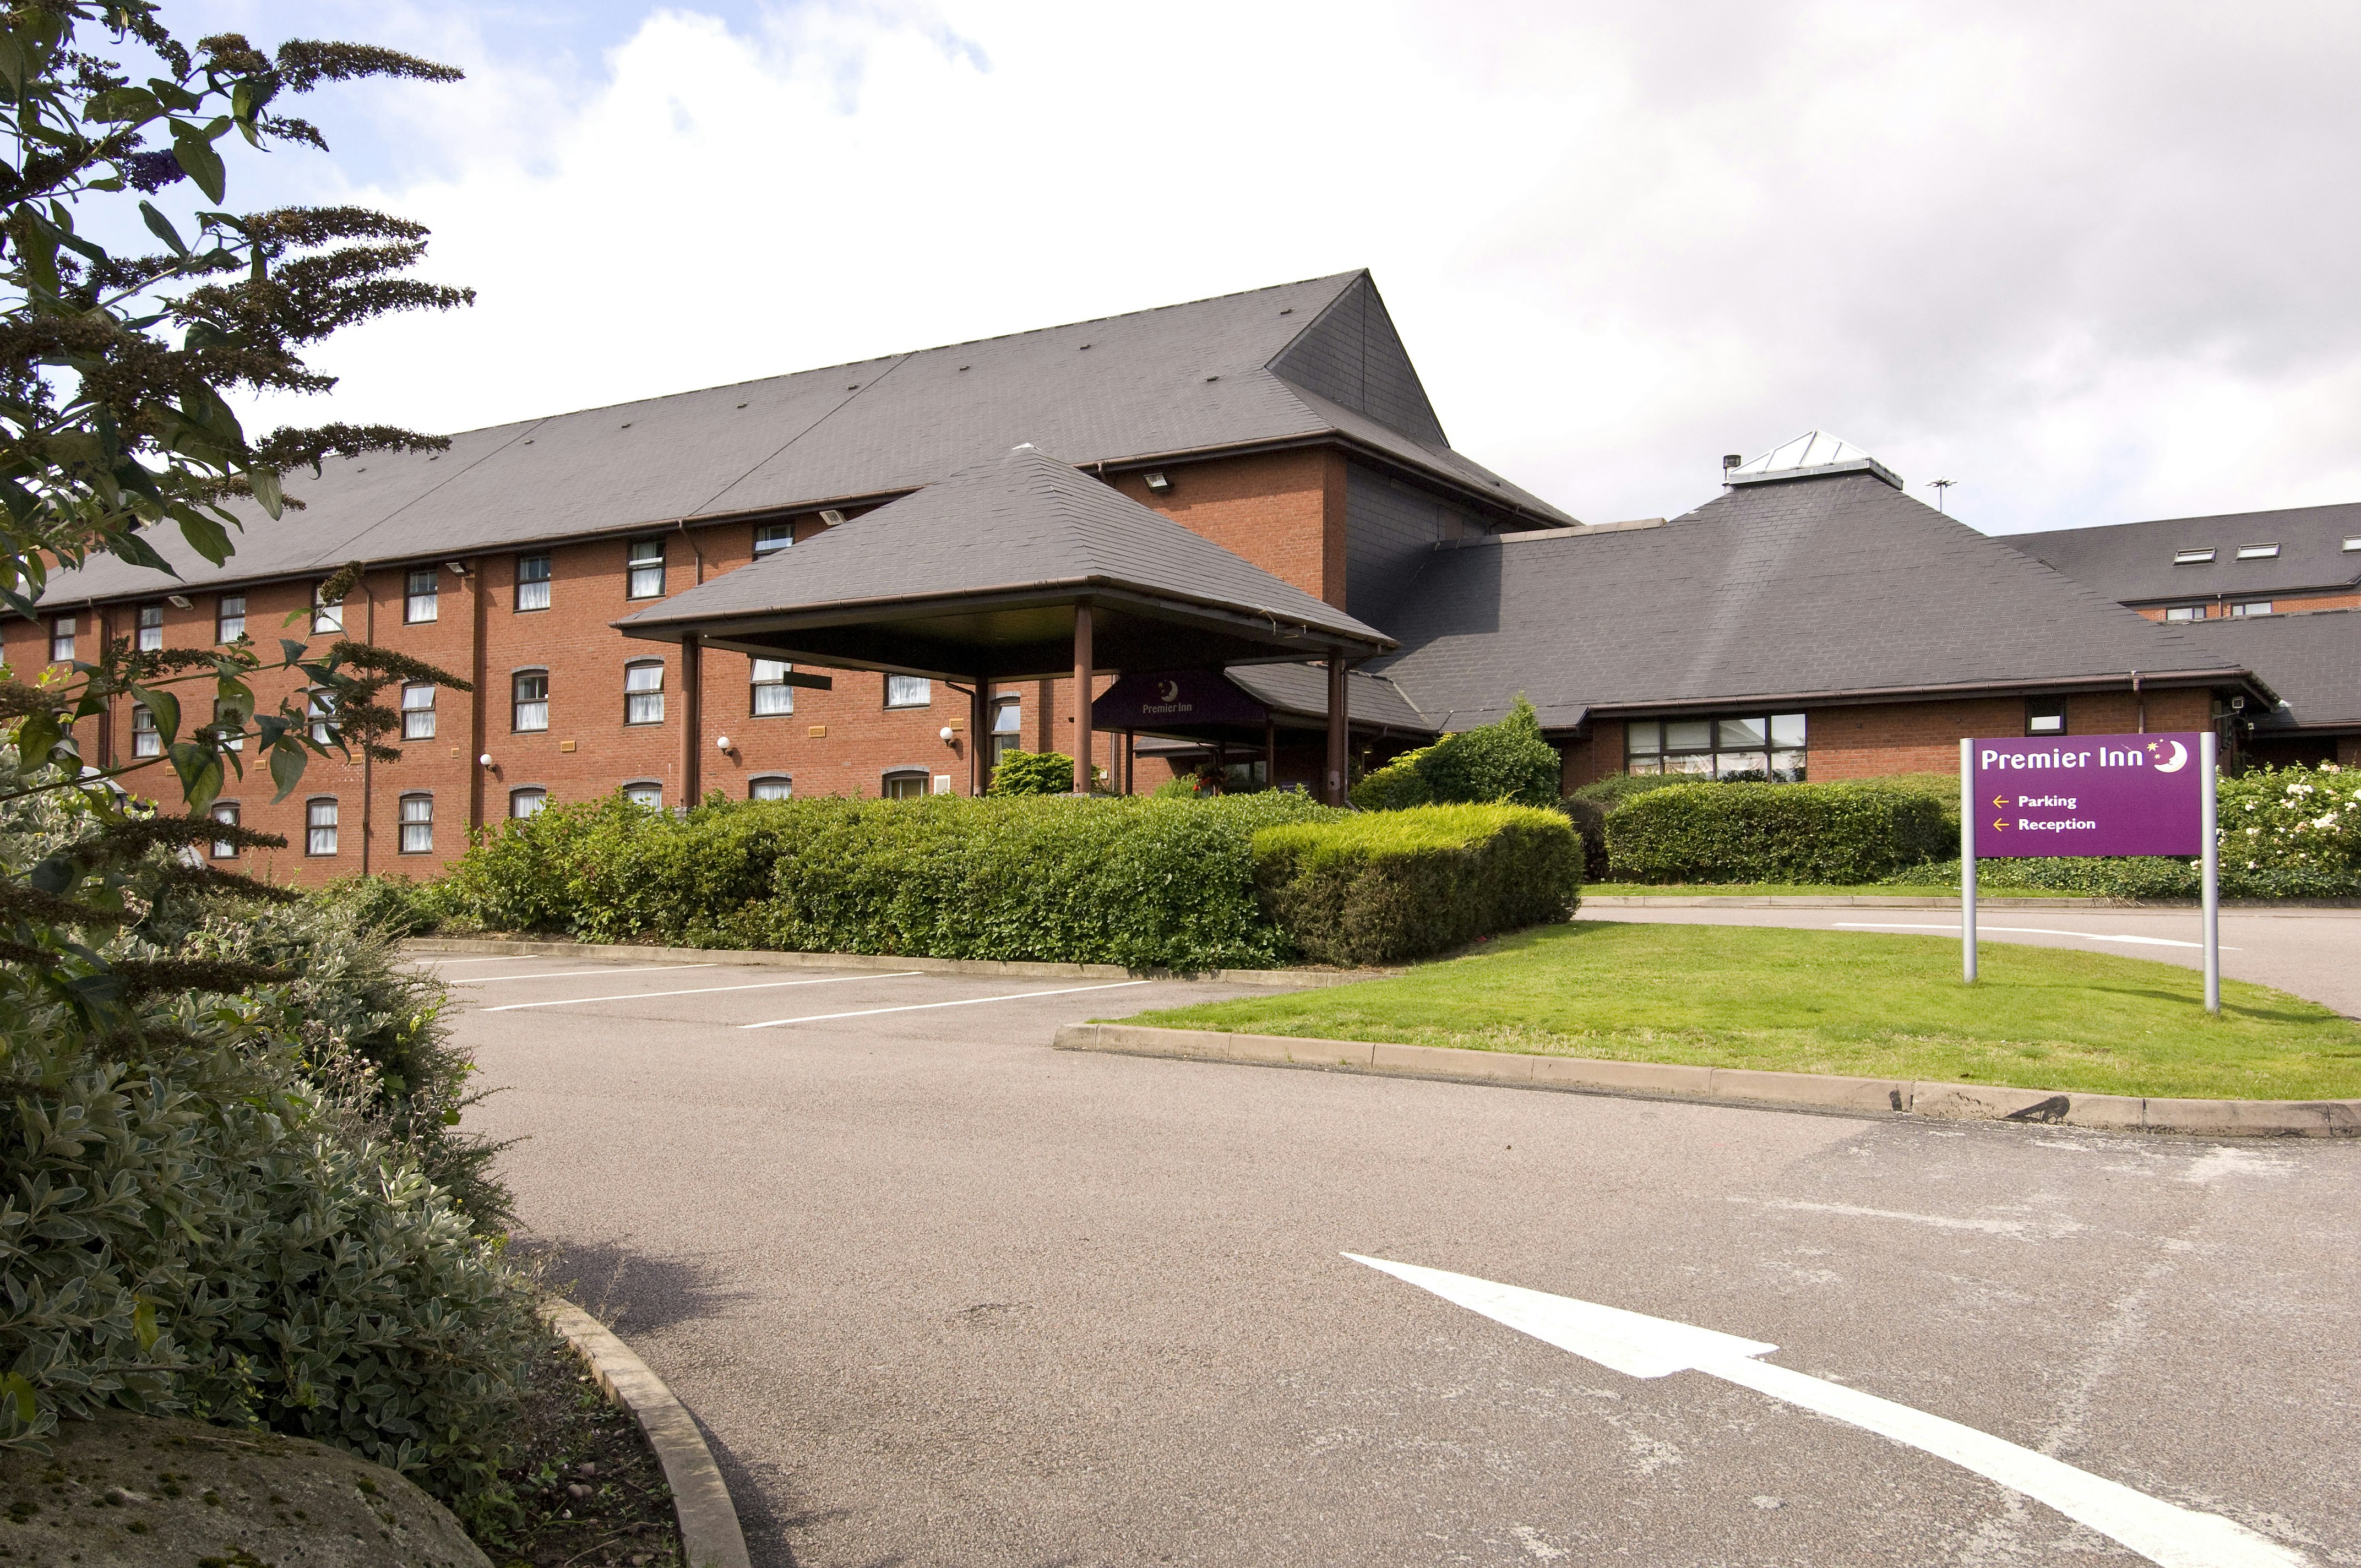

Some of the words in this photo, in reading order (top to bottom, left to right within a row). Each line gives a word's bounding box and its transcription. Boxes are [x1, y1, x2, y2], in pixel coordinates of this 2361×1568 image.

[1143, 703, 1177, 714] Premier
[1178, 702, 1192, 712] Inn
[1982, 748, 2091, 770] Premier
[2099, 747, 2143, 767] Inn
[2018, 794, 2077, 809] Parking
[2018, 818, 2096, 833] Reception
